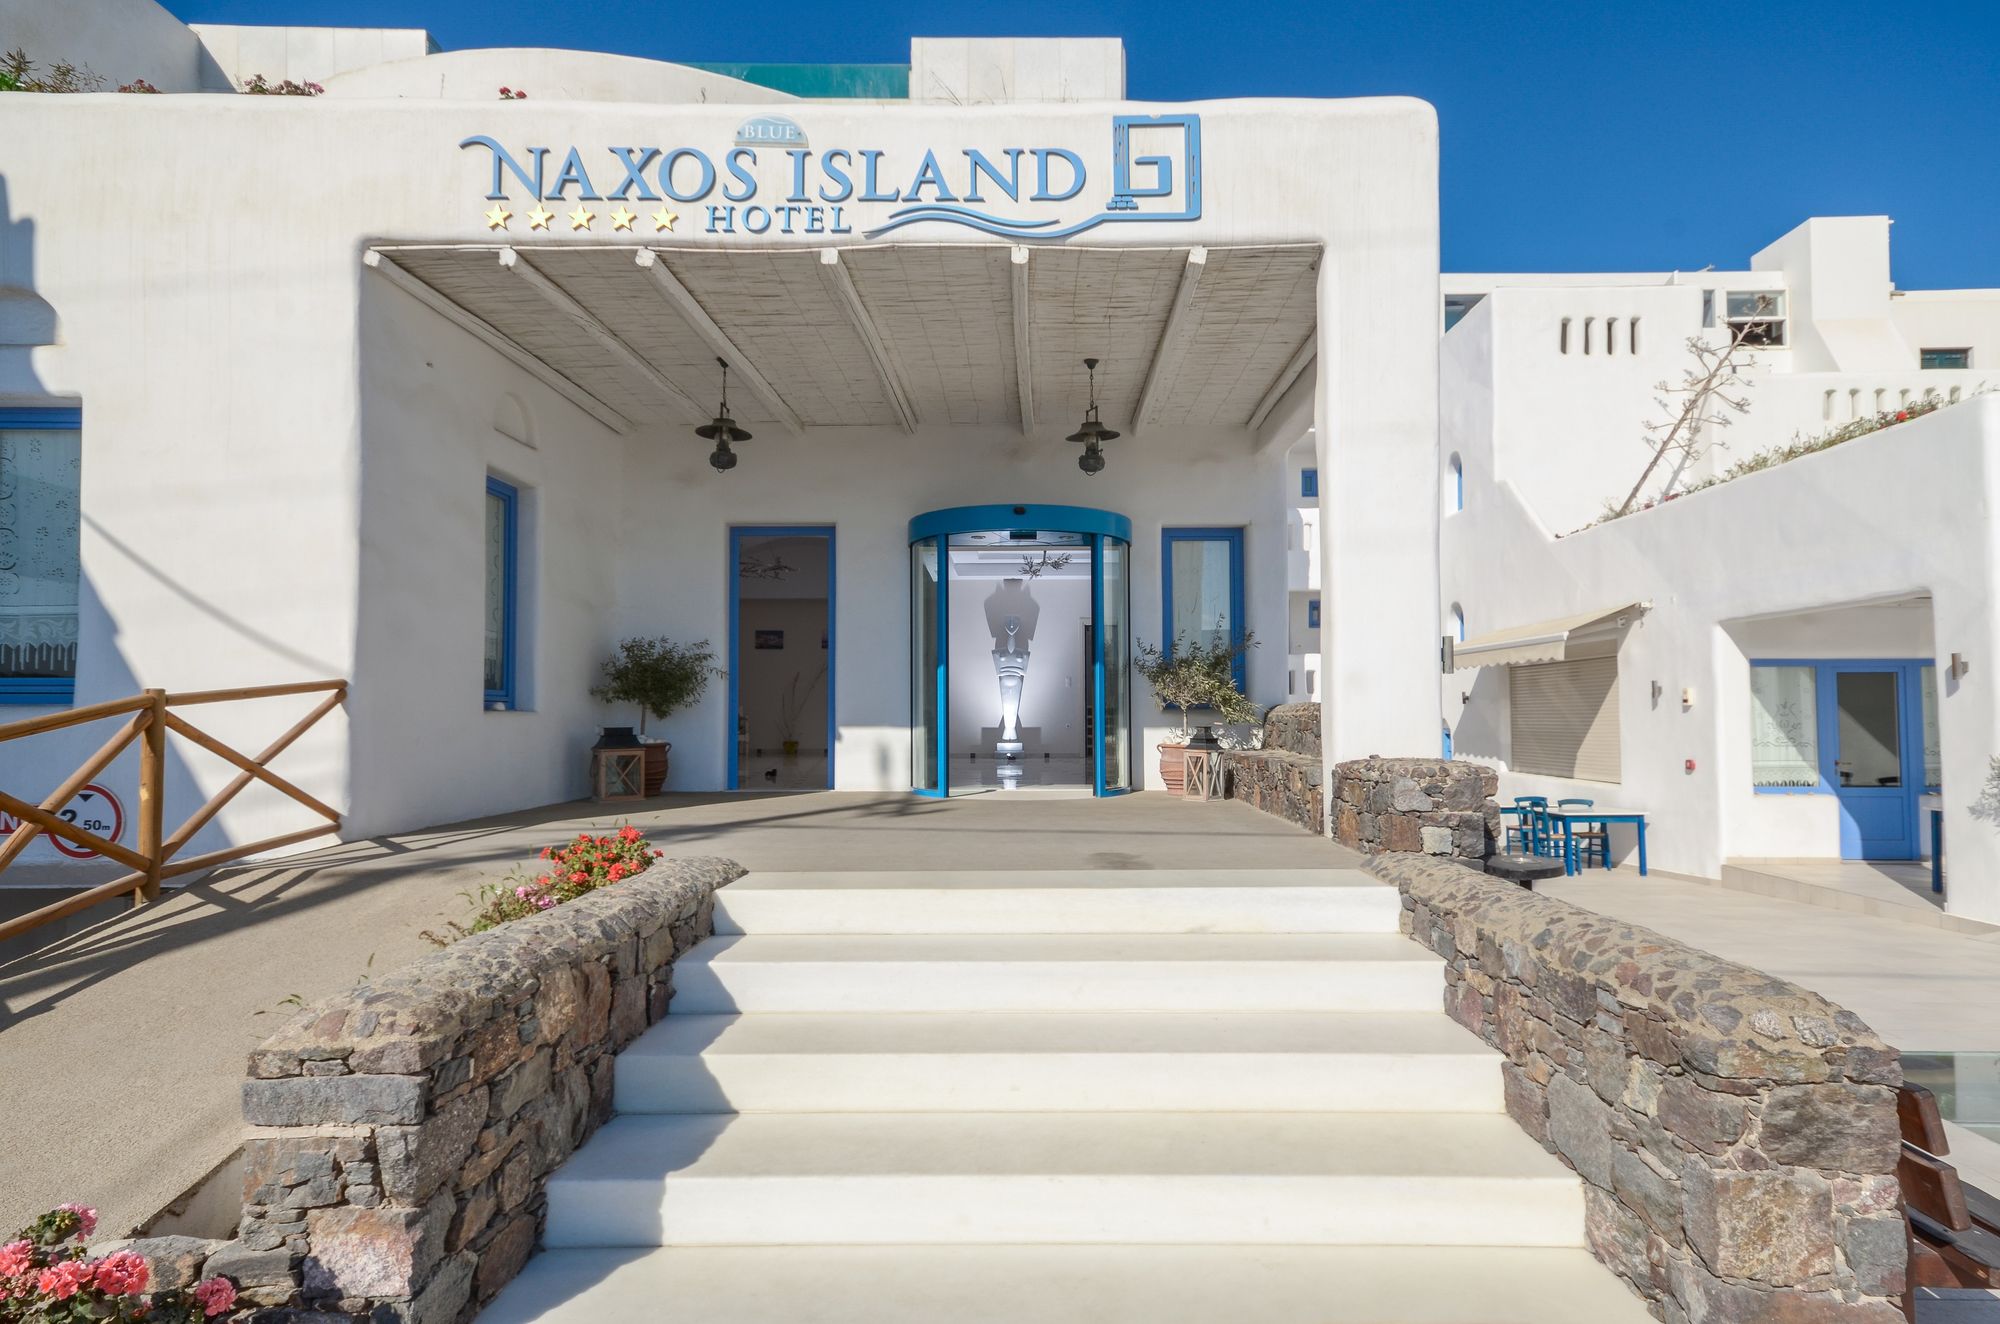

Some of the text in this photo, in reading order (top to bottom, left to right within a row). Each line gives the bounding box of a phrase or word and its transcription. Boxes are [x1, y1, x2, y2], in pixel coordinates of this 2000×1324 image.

[743, 124, 797, 140] BLUE
[459, 135, 1087, 202] NAXOS ISLAND
[704, 205, 852, 234] HOTEL
